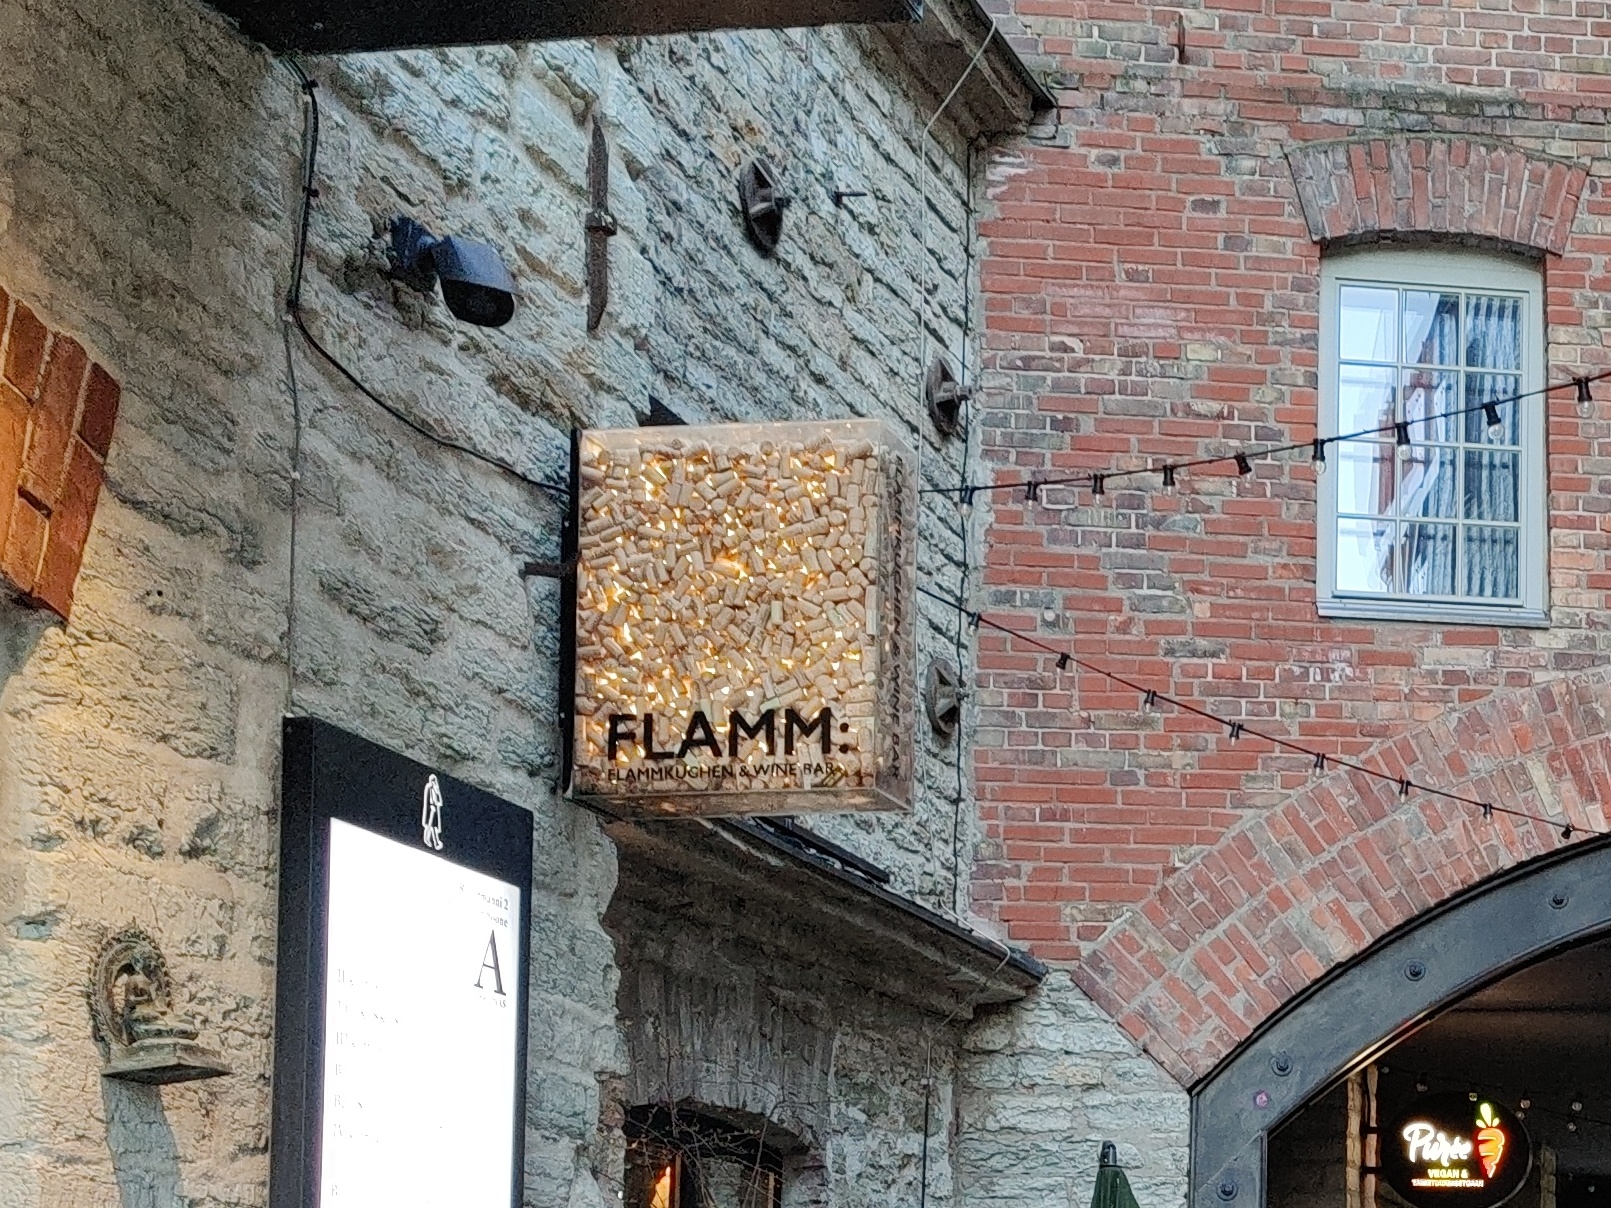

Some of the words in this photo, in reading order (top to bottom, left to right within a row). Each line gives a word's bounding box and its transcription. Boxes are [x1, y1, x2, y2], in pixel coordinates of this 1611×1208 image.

[608, 707, 849, 761] FLAMM:
[608, 764, 735, 782] FLAMMKUCHEN
[739, 764, 750, 777] &
[753, 763, 798, 776] WINE
[803, 762, 837, 775] BAR
[474, 929, 507, 997] A
